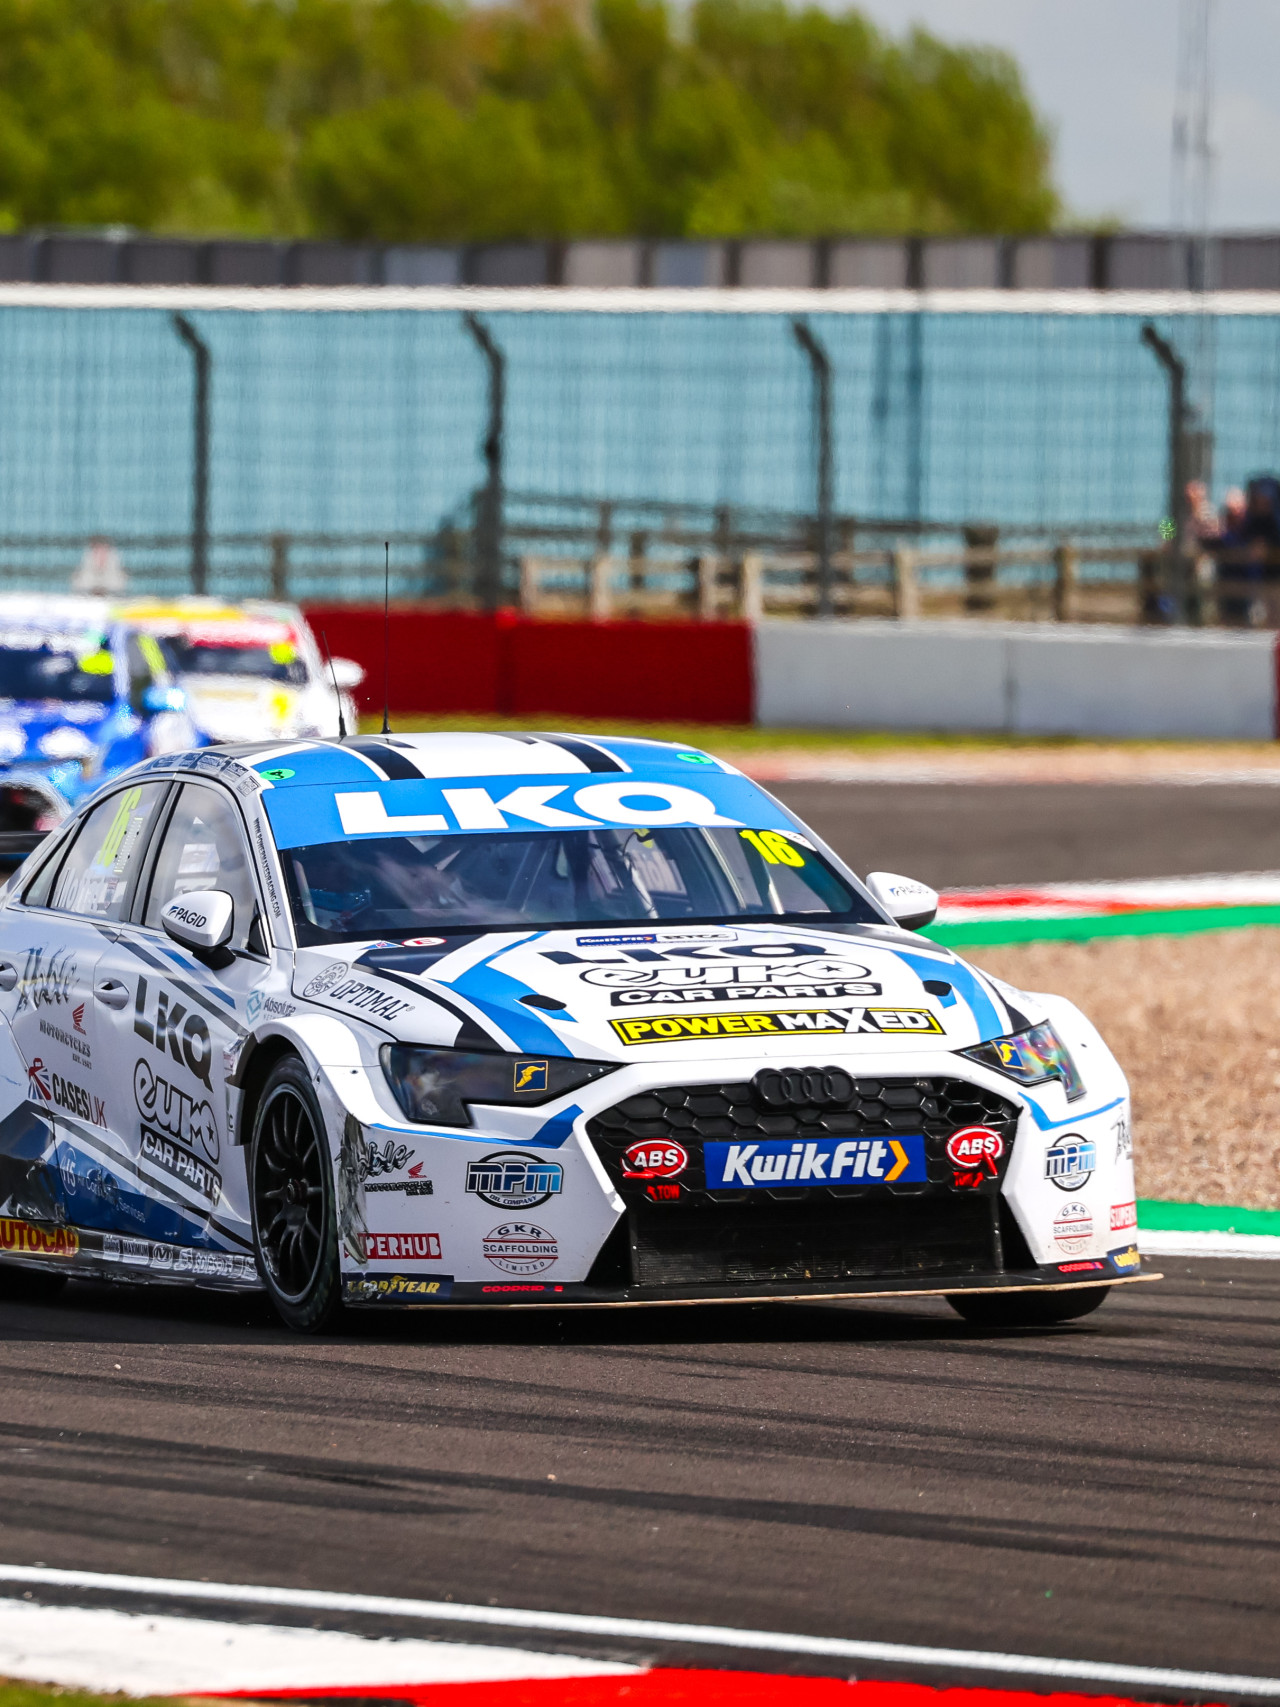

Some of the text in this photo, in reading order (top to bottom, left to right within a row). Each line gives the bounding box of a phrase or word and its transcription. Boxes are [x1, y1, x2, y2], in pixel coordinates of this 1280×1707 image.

[335, 781, 747, 834] LKQ
[739, 830, 806, 868] 16
[174, 907, 207, 928] PAGID
[537, 943, 849, 965] LKQ
[579, 960, 873, 987] euro
[329, 979, 409, 1021] OPTIMAL
[619, 983, 879, 1003] CAR PARTS
[133, 974, 214, 1094] LKQ
[629, 1015, 779, 1039] POWER
[39, 1019, 91, 1058] MOTORCYCLES
[133, 1057, 220, 1165] euro
[956, 1136, 995, 1156] ABS
[143, 1132, 223, 1202] CAR PARTS
[634, 1149, 679, 1168] ABS
[489, 1193, 537, 1205] OIL COMPANY
[656, 1185, 680, 1199] TOW
[1061, 1204, 1086, 1217] GKR
[497, 1225, 542, 1238] GKR
[483, 1244, 558, 1253] SCAFFOLDING
[498, 1260, 545, 1272] LIMITED
